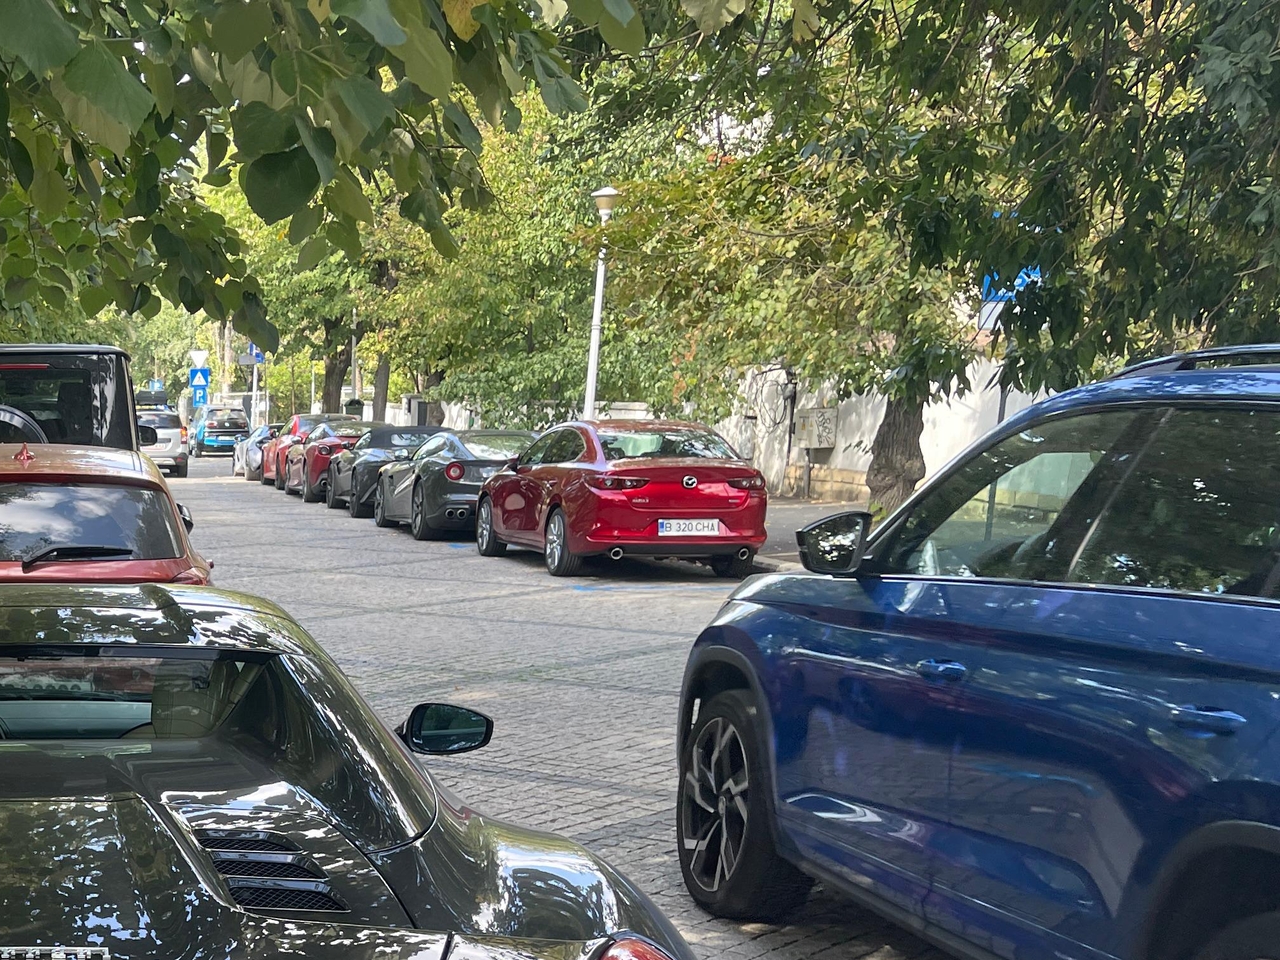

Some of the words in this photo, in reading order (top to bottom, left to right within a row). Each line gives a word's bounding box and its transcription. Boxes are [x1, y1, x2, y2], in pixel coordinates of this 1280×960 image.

[196, 390, 204, 401] P
[665, 522, 672, 532] B
[676, 522, 694, 532] 320
[695, 522, 716, 532] CHA
